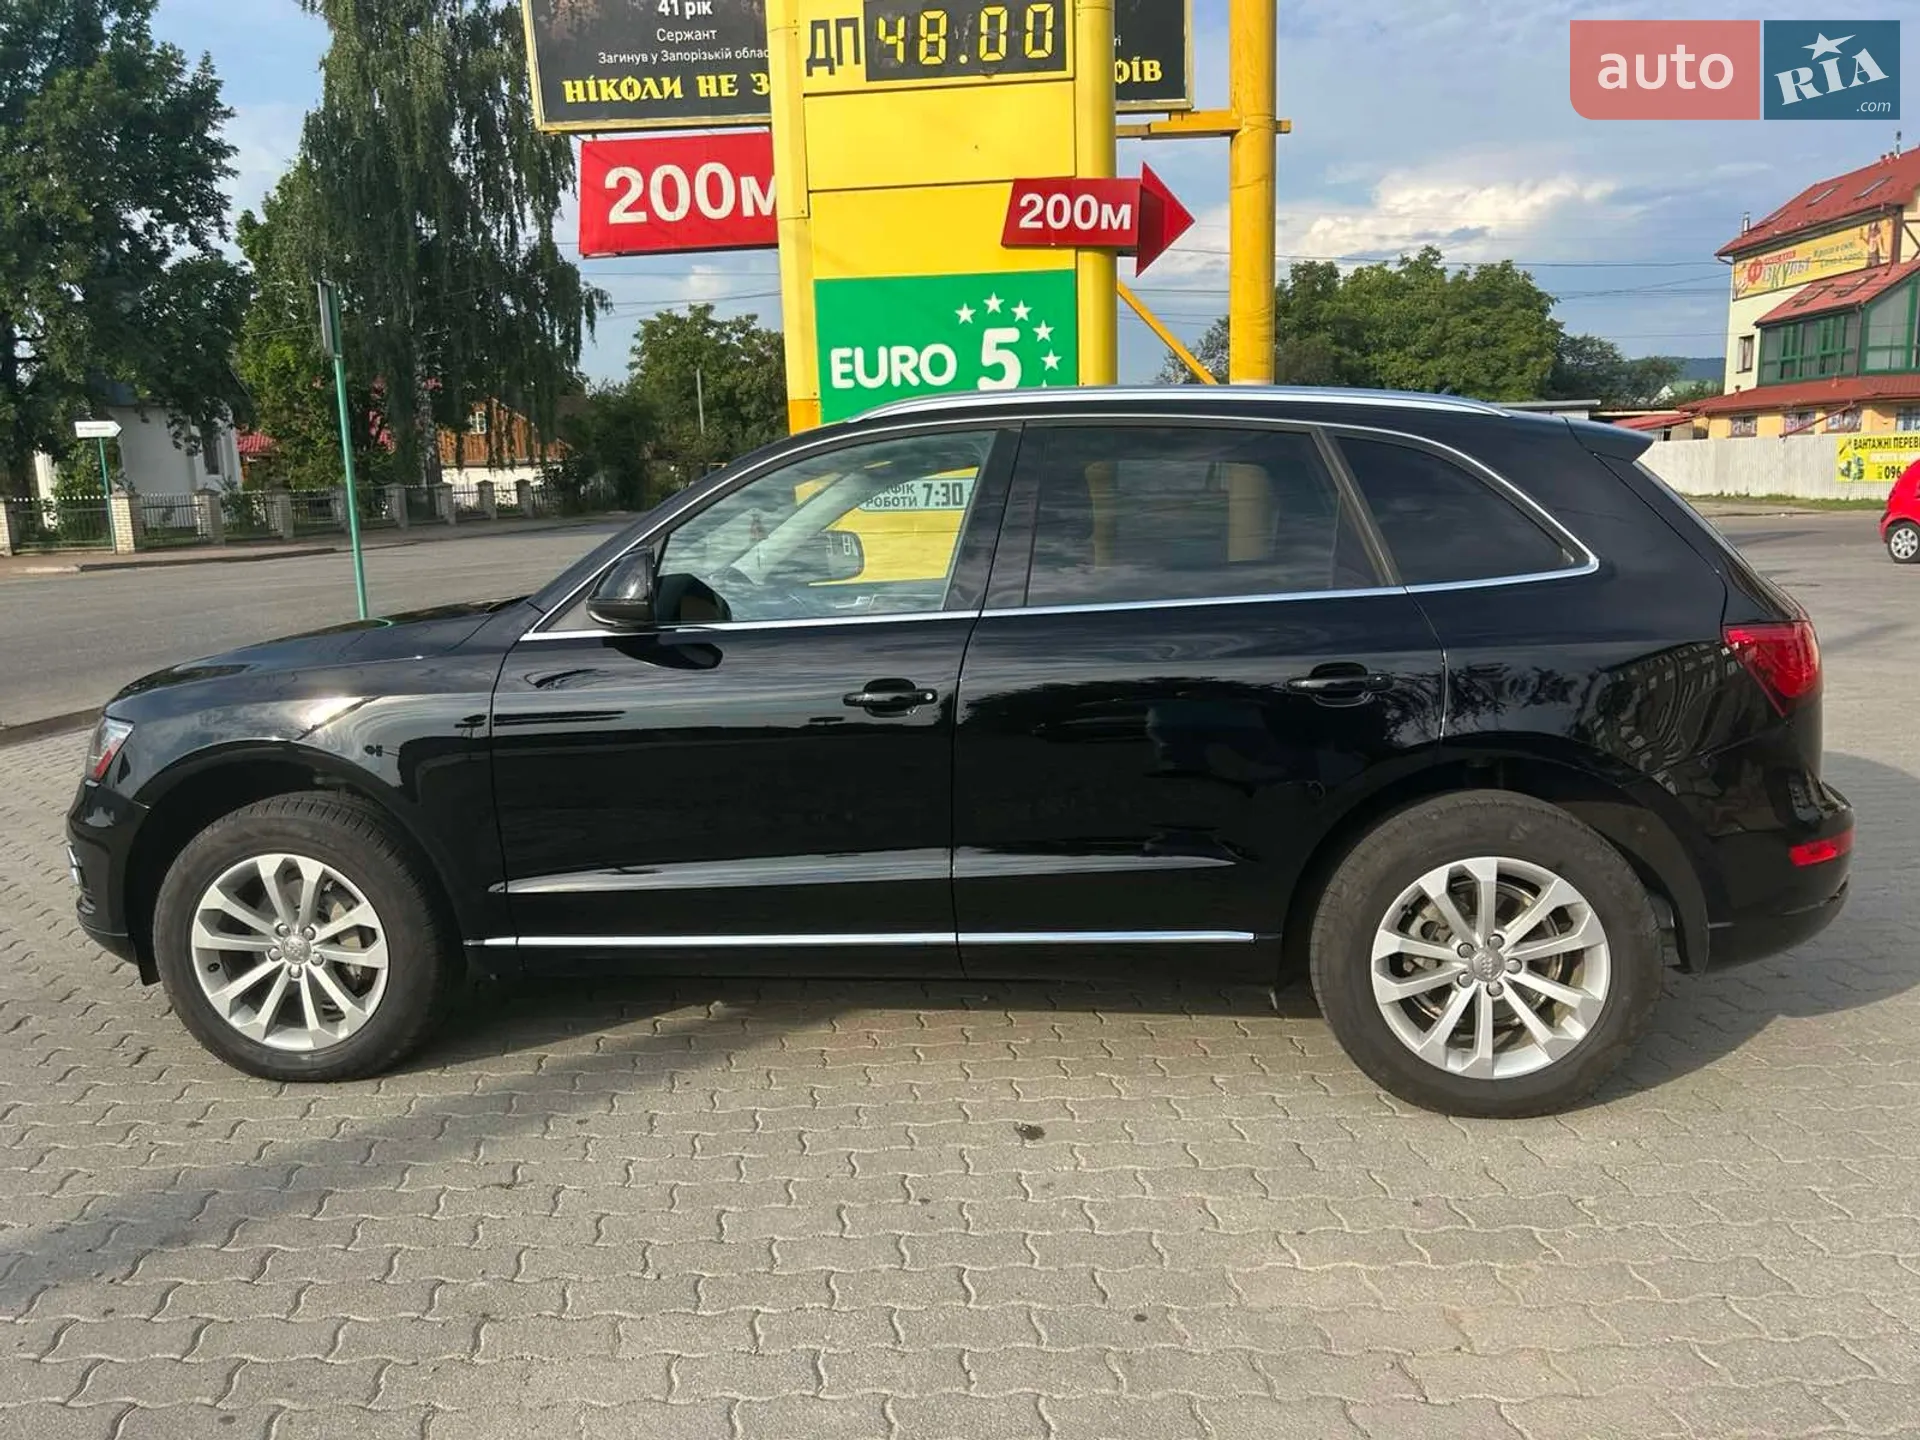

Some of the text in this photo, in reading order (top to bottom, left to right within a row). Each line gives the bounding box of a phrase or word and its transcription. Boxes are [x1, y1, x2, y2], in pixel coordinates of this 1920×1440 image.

[658, 0, 713, 20] 41 рік
[656, 28, 718, 44] Сержант
[877, 3, 1054, 66] 48.00
[598, 51, 648, 65] Загинув
[650, 53, 659, 64] у
[661, 48, 732, 62] Запорізькій
[805, 17, 861, 77] ДП
[562, 74, 684, 104] НІКОЛИ
[696, 74, 739, 98] НЕ
[830, 327, 1022, 389] EURO 5
[866, 495, 918, 508] РОБОТИ
[922, 482, 964, 506] 7:30
